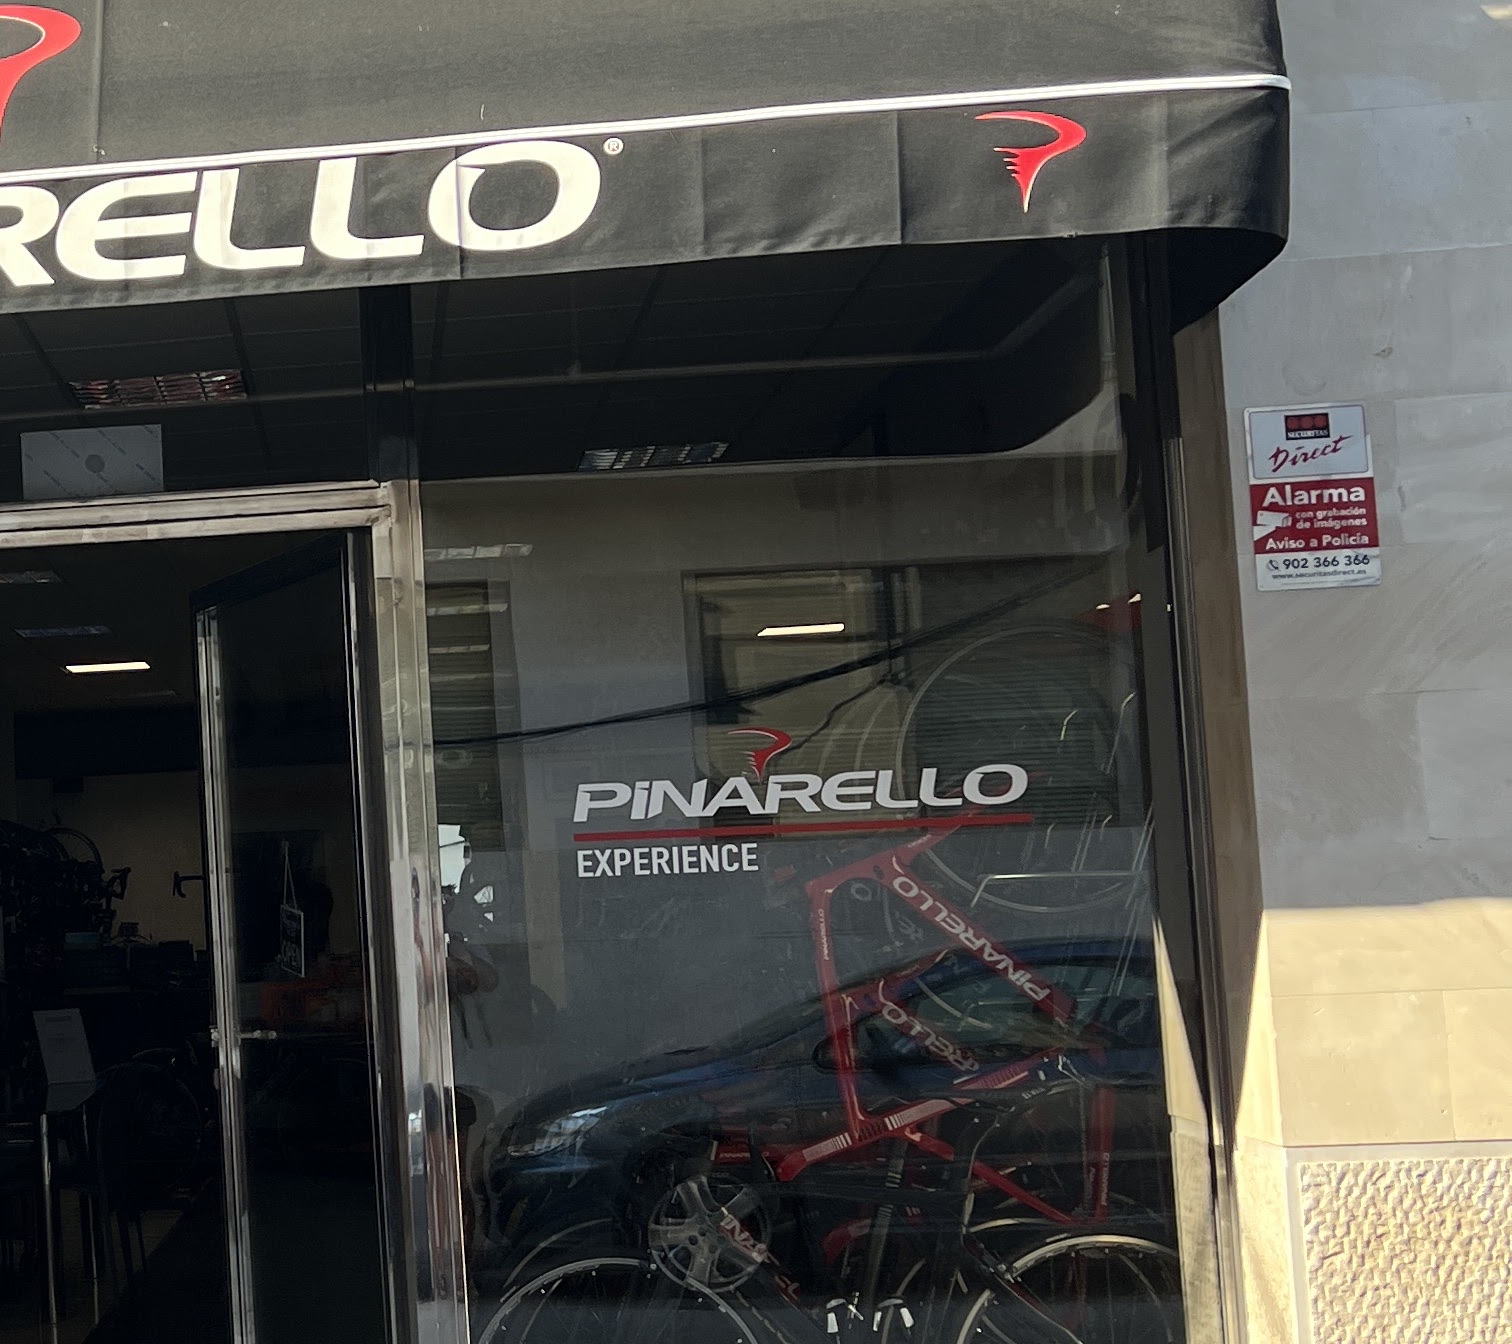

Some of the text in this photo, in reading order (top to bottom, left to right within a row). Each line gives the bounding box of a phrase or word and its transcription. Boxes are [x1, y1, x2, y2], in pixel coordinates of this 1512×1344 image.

[1268, 435, 1353, 473] Direct
[1262, 484, 1365, 508] Alarma
[1295, 507, 1366, 520] con grabación
[1296, 518, 1367, 530] de imágenes
[1265, 533, 1369, 550] Aviso a Policía
[1282, 554, 1370, 570] 902 366 366
[1272, 568, 1367, 580] www.securitasdirect.es
[573, 763, 1029, 823] PINARELLO
[577, 842, 759, 878] EXPERIENCE
[893, 876, 1052, 1001] PINARELLO
